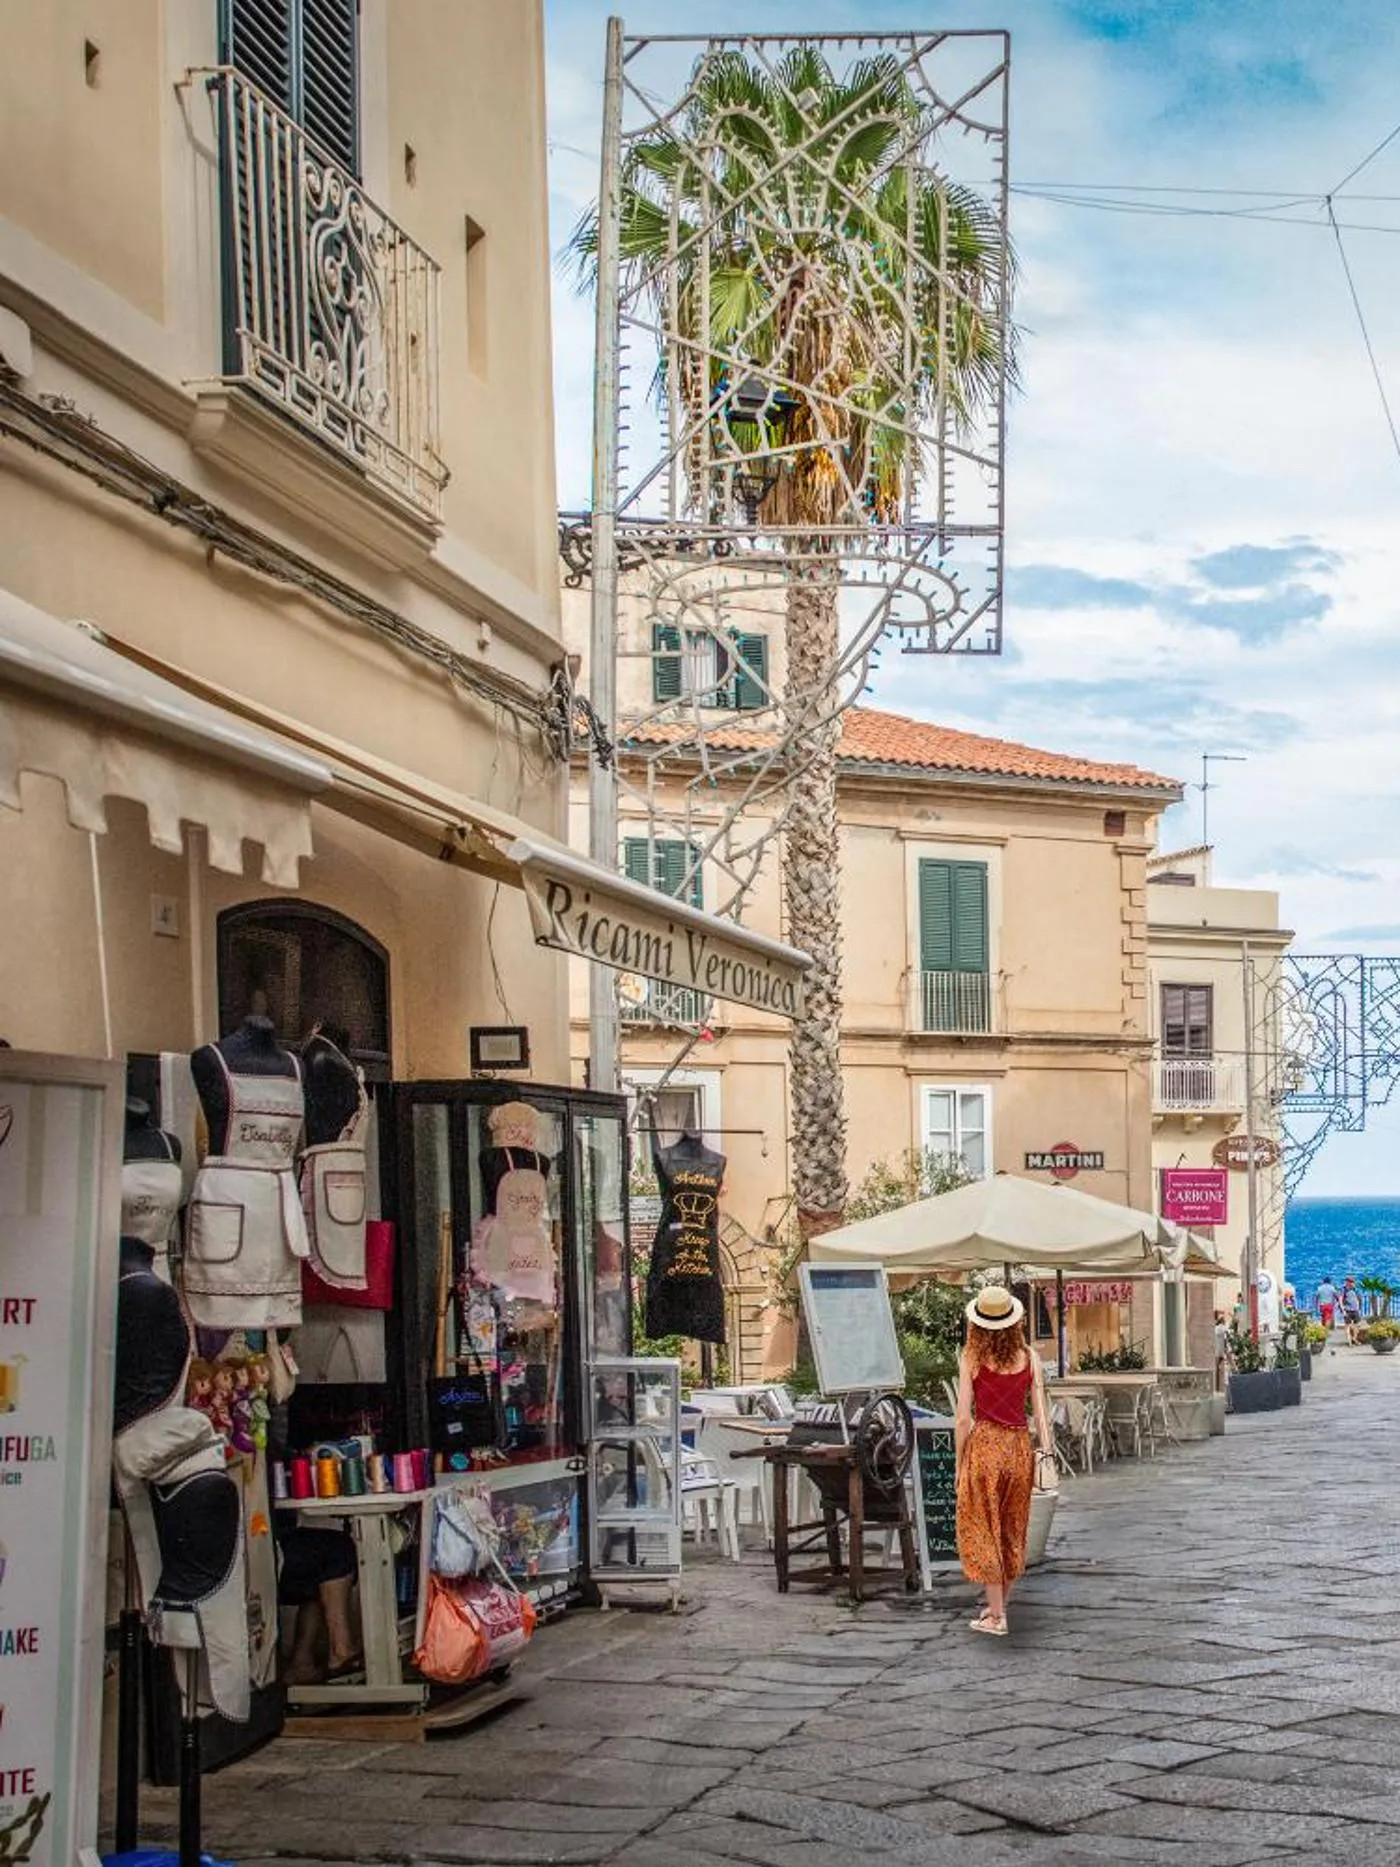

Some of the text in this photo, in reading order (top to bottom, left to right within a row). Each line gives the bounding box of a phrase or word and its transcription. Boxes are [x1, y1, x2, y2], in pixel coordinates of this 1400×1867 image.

[544, 879, 799, 1013] Ricami Veronica
[1028, 1154, 1101, 1168] MARTINI
[1166, 1188, 1225, 1203] CARBONE
[0, 1627, 39, 1656] AKE
